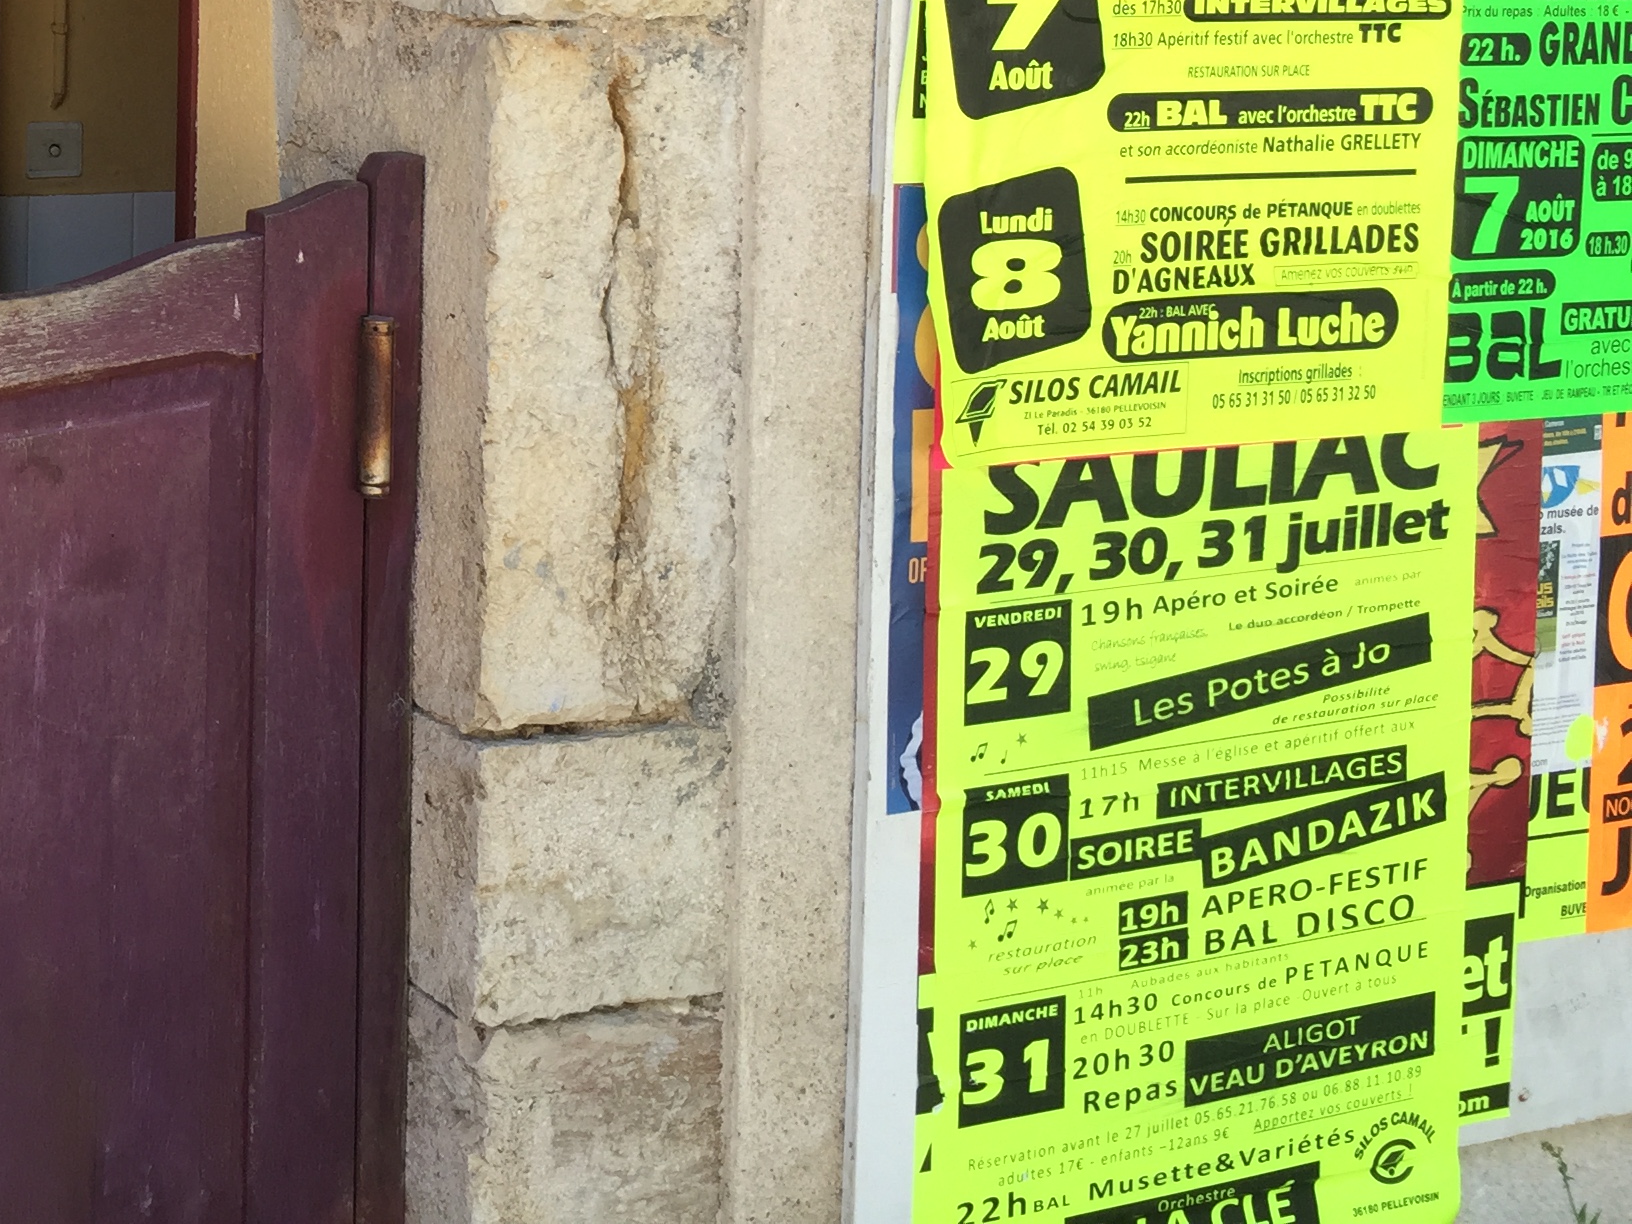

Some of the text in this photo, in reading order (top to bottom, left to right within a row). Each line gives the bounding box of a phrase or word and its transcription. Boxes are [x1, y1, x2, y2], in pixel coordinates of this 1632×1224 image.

[1141, 0, 1182, 15] 17h30
[1501, 5, 1587, 20] repas Adultes
[1112, 22, 1402, 49] 18h30 Apéritif festif avec l'orchestre TTC
[988, 59, 1054, 91] Août
[1187, 64, 1310, 78] RESTAURATION SUR PLACE
[1124, 92, 1418, 129] 22h BAL avec TTC
[1458, 76, 1600, 129] SÉBASTIEN
[1119, 132, 1422, 157] et son accordéoniste Nathalie GRELLETY
[1462, 139, 1580, 170] DIMANCHE
[979, 206, 1053, 235] Lundi
[1114, 198, 1421, 225] 14h30 CONCOURS de PÉTANQUE doublettes
[1463, 175, 1520, 255] 7
[1525, 192, 1576, 223] AOÛT
[1139, 219, 1420, 264] SOIRÉE GRILLADES
[1519, 227, 1574, 251] 2016
[970, 237, 1063, 312] 8
[1112, 262, 1256, 295] D'AGNEAUX
[1500, 278, 1533, 296] de 22
[981, 313, 1046, 343] Août
[1165, 305, 1186, 319] BAL
[1110, 300, 1386, 357] Yannich Luche
[1008, 369, 1182, 405] SILOS CAMAIL
[1238, 364, 1303, 385] Inscriptions
[1113, 401, 1167, 414] PELLEVOISIN
[1547, 504, 1599, 520] musée de
[976, 498, 1450, 595] 29, 30, 31 juillet
[1151, 574, 1339, 616] Apéro Soirée
[974, 606, 1063, 629] VENDREDI
[1247, 597, 1421, 630] duo accordéon Trompette
[966, 639, 1064, 706] 29
[1131, 640, 1391, 726] Les Potes Jo
[1289, 692, 1439, 724] restauration sur place
[1322, 684, 1391, 704] Possibilité
[1139, 724, 1386, 773] Messe offert
[985, 781, 1050, 802] SAMEDI
[1170, 751, 1403, 808] INTERVILLAGES
[965, 811, 1062, 878] 30
[1076, 788, 1436, 880] SOIREE BANDAZIK
[1120, 857, 1428, 933] 19h APERO-FESTIF
[1119, 893, 1415, 969] 23h BAL DISCO
[1130, 970, 1190, 989] Aubades
[1171, 940, 1429, 1007] Concours de PETANQUE
[965, 1004, 1060, 1033] DIMANCHE
[1254, 994, 1290, 1013] place
[1262, 1014, 1363, 1055] ALIGOT
[962, 1038, 1050, 1106] 31
[1189, 1029, 1429, 1098] VEAU D'AVEYRON
[1083, 1079, 1178, 1114] Repas
[968, 1143, 1056, 1172] Réservation
[1033, 1194, 1071, 1213] BAL
[1157, 1185, 1236, 1214] Orchestre
